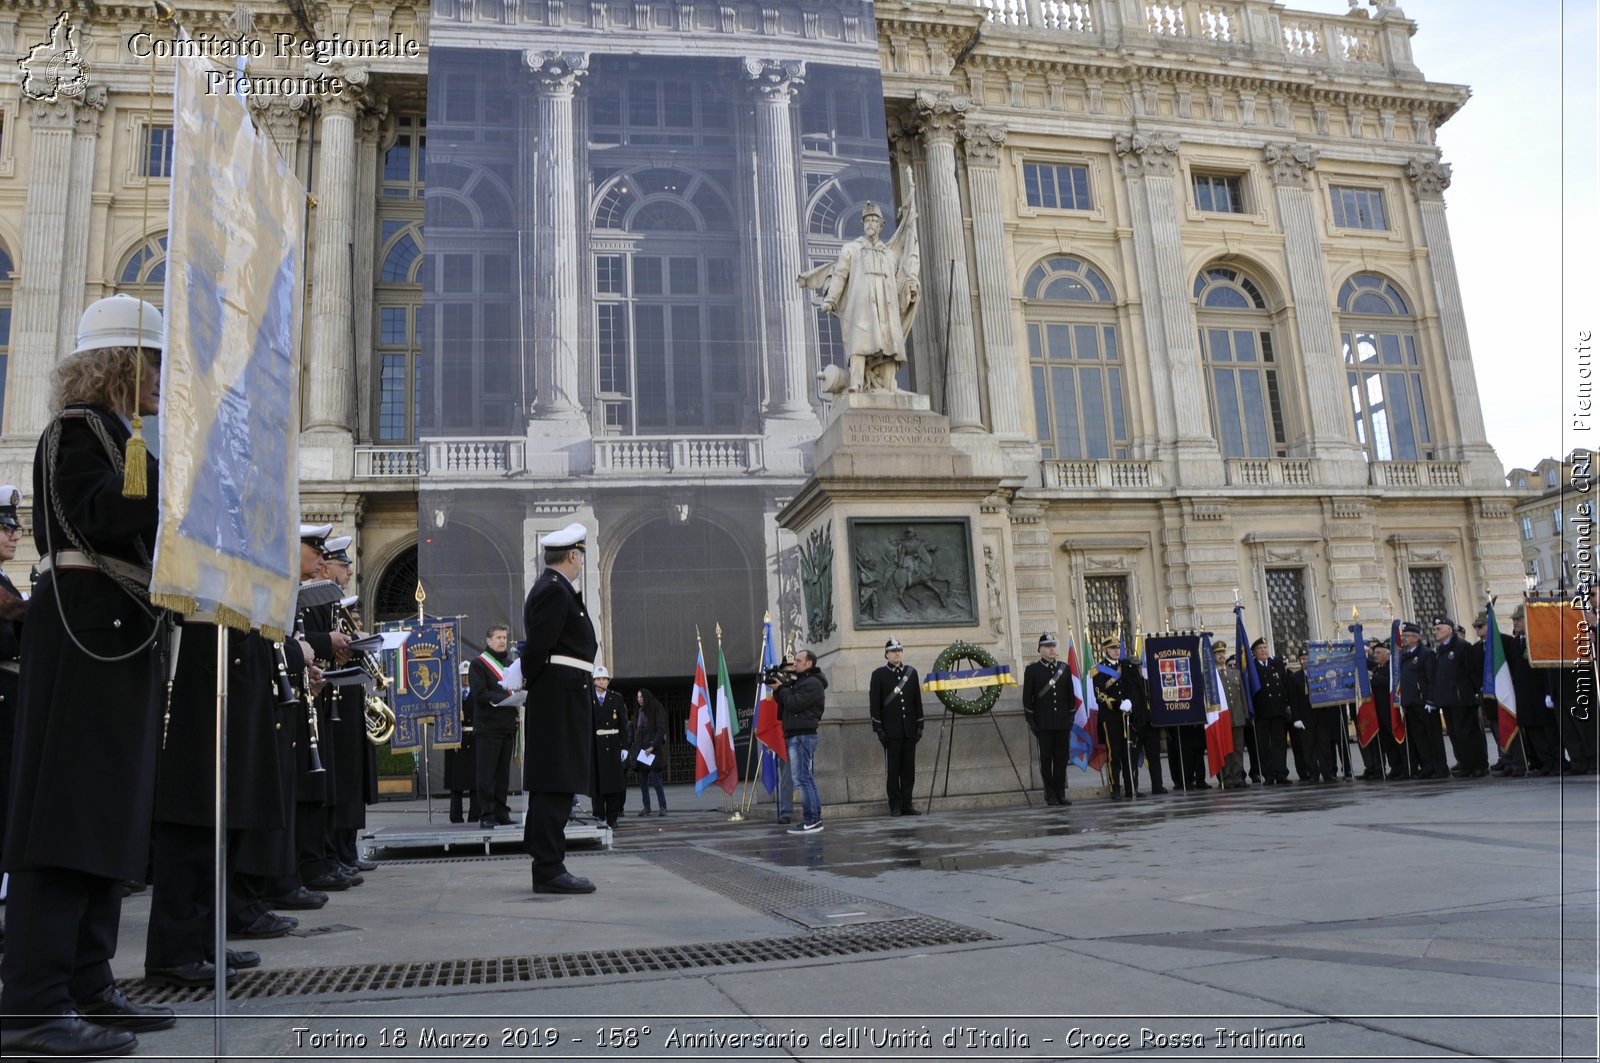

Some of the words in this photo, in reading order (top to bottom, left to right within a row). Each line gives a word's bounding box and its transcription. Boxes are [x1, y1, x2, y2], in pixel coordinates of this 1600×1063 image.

[884, 434, 920, 444] GENNAIO
[1154, 648, 1191, 660] ASSOARMA
[428, 701, 450, 710] TORINO
[1165, 701, 1190, 711] TORINO
[739, 718, 749, 729] CRT
